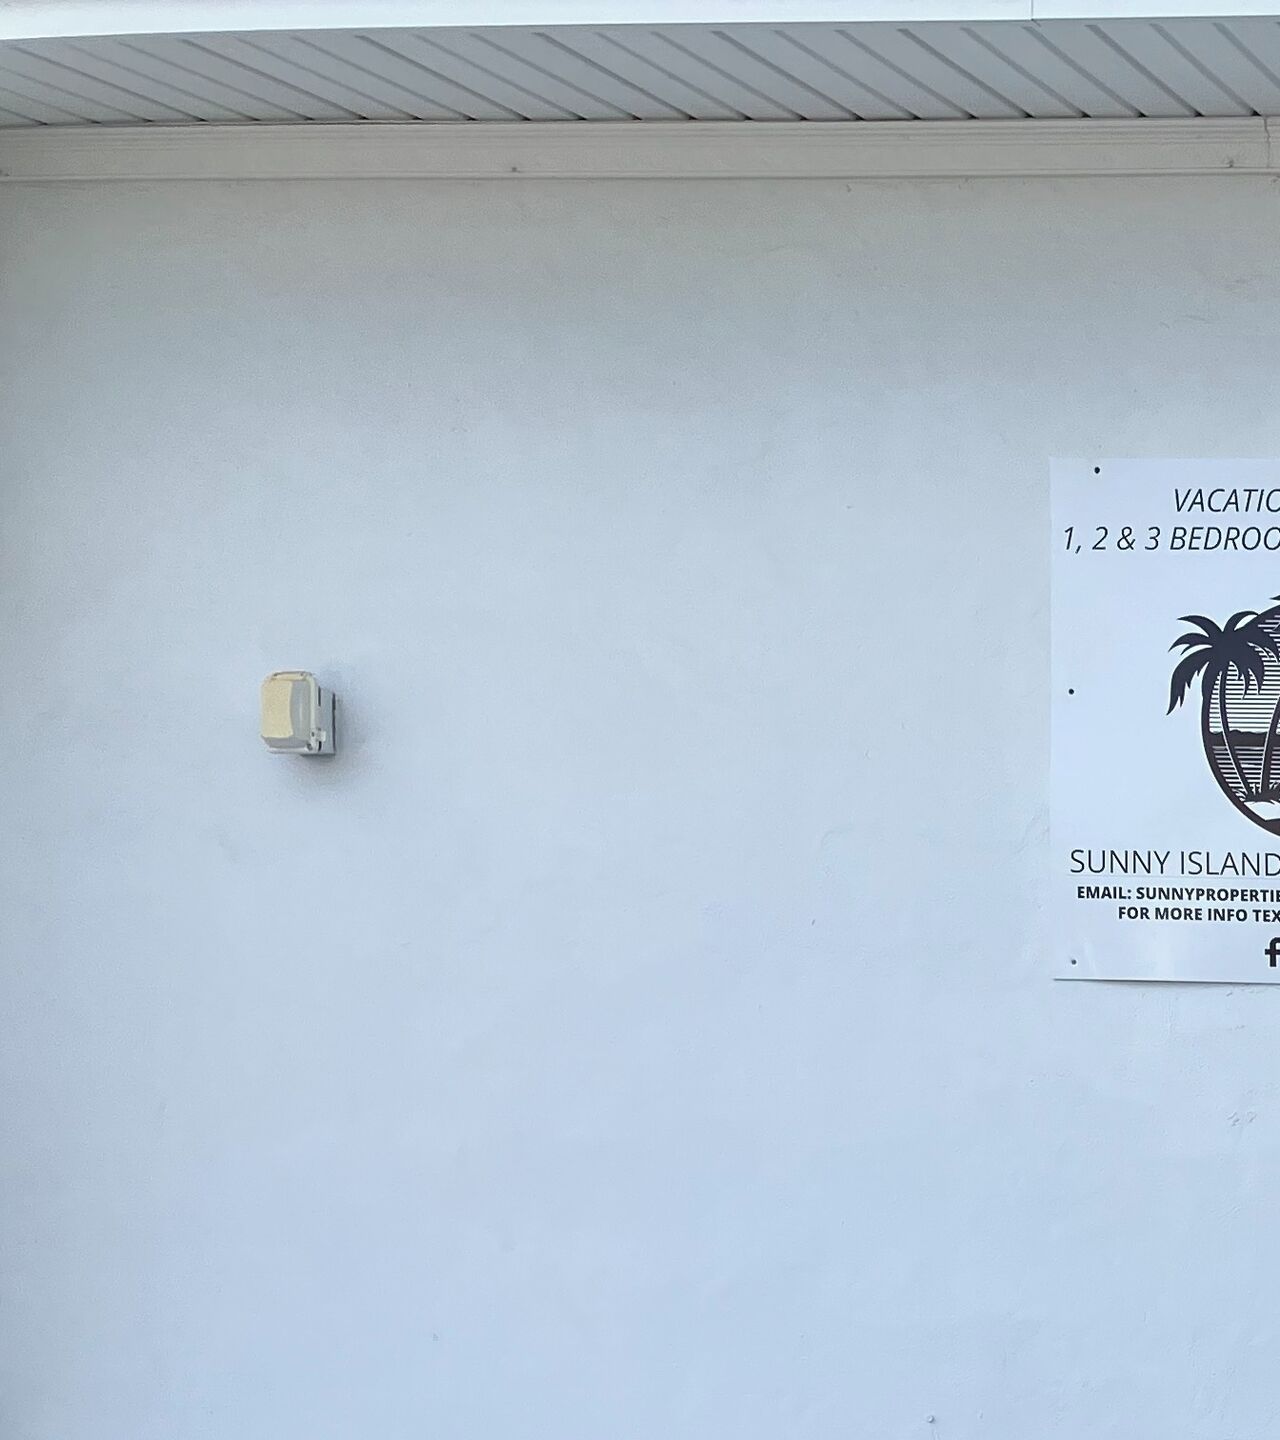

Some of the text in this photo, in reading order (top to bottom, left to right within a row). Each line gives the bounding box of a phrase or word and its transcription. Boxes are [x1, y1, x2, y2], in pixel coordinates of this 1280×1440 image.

[1063, 526, 1082, 554] 1,
[1092, 526, 1109, 550] 2
[1116, 526, 1136, 551] &
[1144, 526, 1161, 551] 3
[1070, 849, 1171, 875] SUNNY
[1076, 886, 1132, 901] EMAIL:
[1118, 906, 1151, 920] FOR
[1154, 906, 1203, 922] MORE
[1207, 908, 1248, 923] INFO
